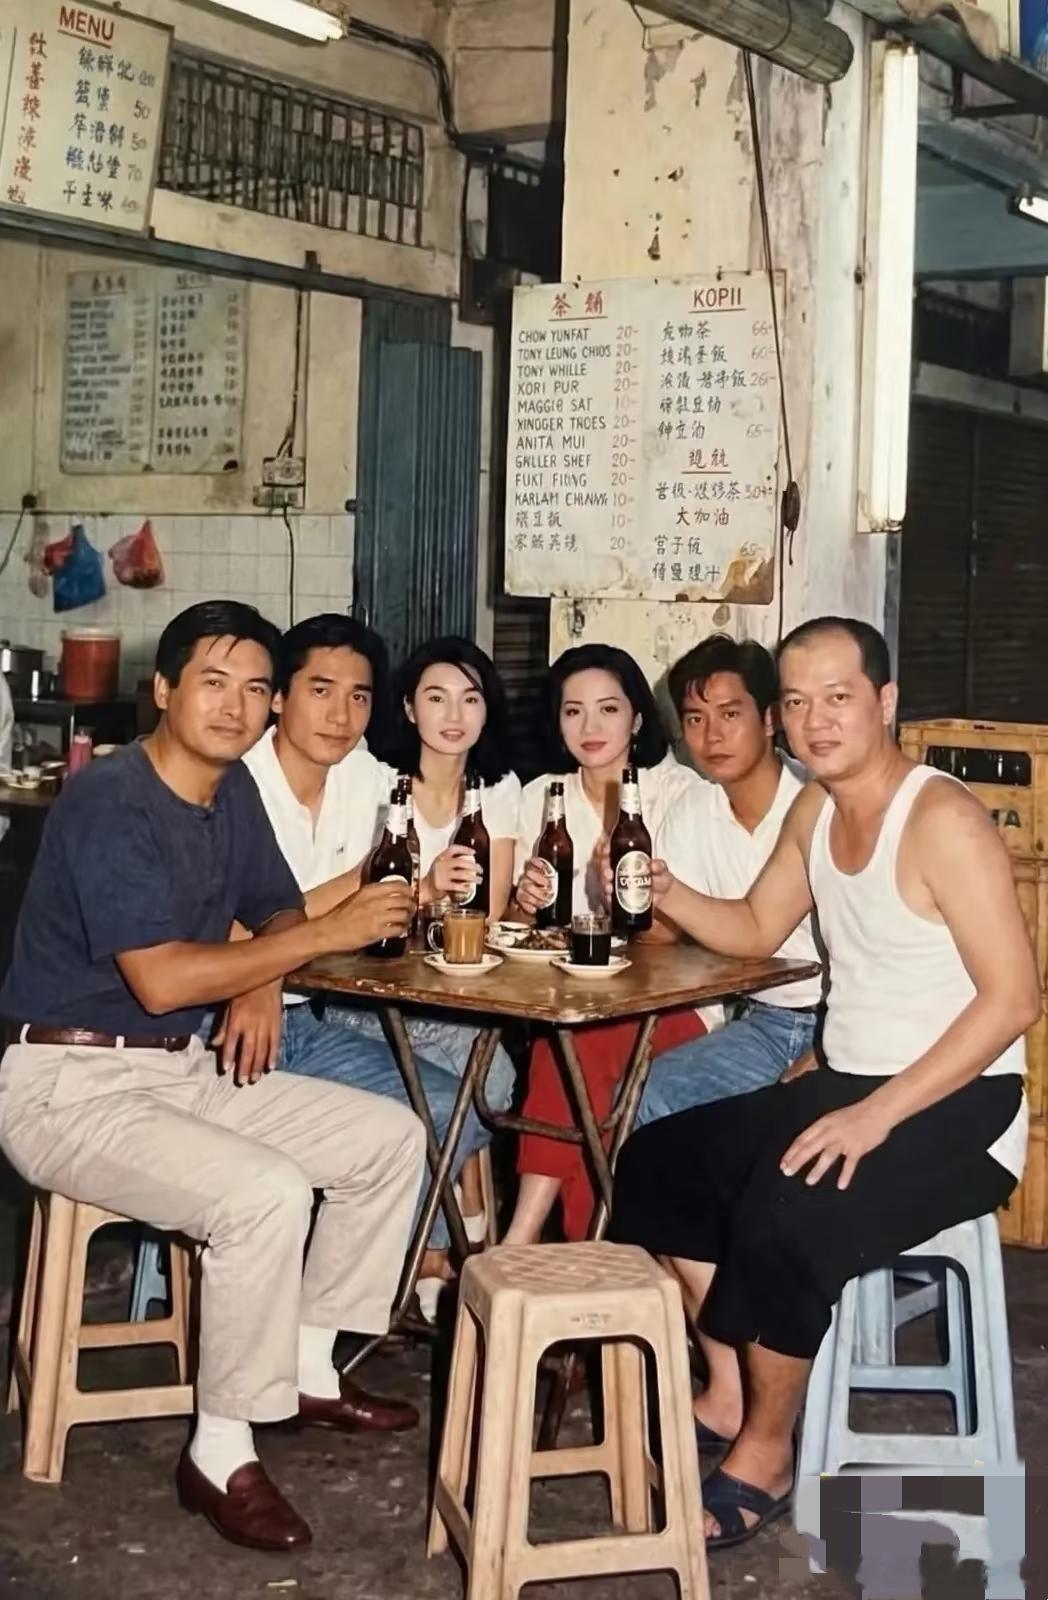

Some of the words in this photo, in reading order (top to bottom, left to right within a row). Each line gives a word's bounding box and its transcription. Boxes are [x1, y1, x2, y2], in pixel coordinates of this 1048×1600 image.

[59, 5, 115, 41] MENU
[693, 287, 741, 307] KOPII
[518, 330, 546, 343] CHOW
[551, 327, 590, 342] YUNFAT
[517, 348, 542, 361] TONY
[546, 346, 577, 360] LEUNG
[517, 363, 544, 378] TONY
[517, 381, 546, 395] KORI
[554, 380, 580, 393] PUR
[515, 435, 554, 450] ANITA
[562, 435, 585, 449] MUI
[675, 506, 730, 527] 大加油
